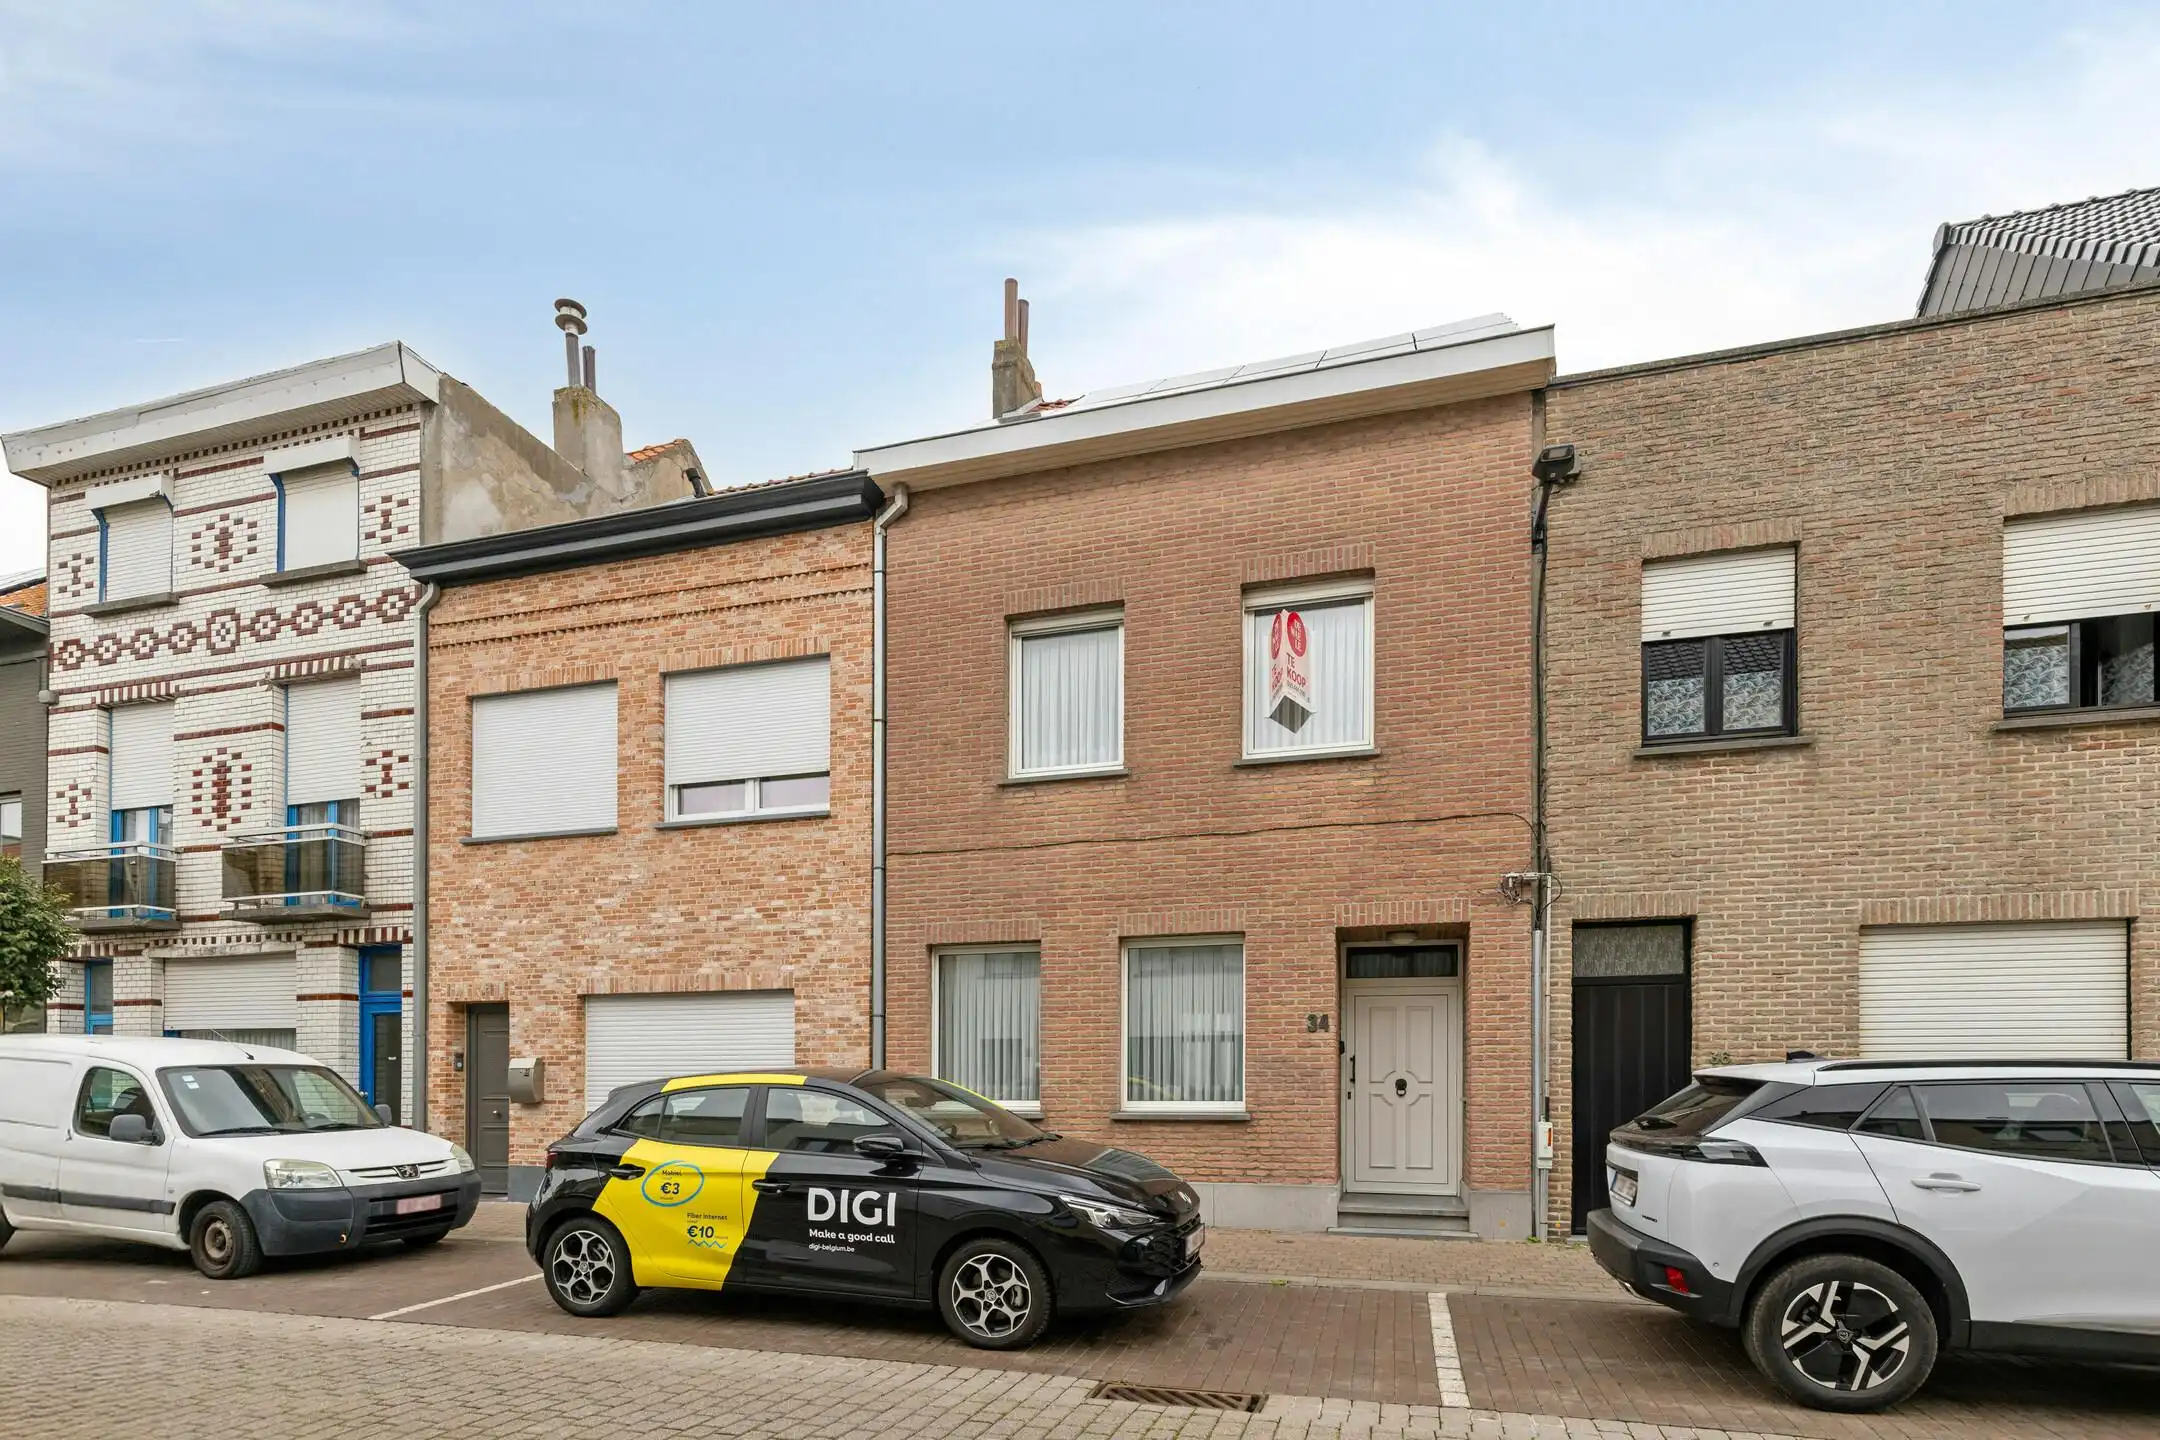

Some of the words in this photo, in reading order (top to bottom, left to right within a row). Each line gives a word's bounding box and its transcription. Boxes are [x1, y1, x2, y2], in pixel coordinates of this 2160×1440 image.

[1286, 652, 1296, 668] TE
[1287, 666, 1306, 688] KOOP
[1307, 1013, 1329, 1033] 34
[660, 1182, 680, 1195] €3
[808, 1187, 897, 1226] DIGI
[687, 1225, 715, 1239] €10
[809, 1228, 837, 1239] Make
[838, 1232, 846, 1240] a
[847, 1232, 873, 1243] good
[874, 1234, 896, 1244] call
[808, 1243, 855, 1252] digi-belgium.be
